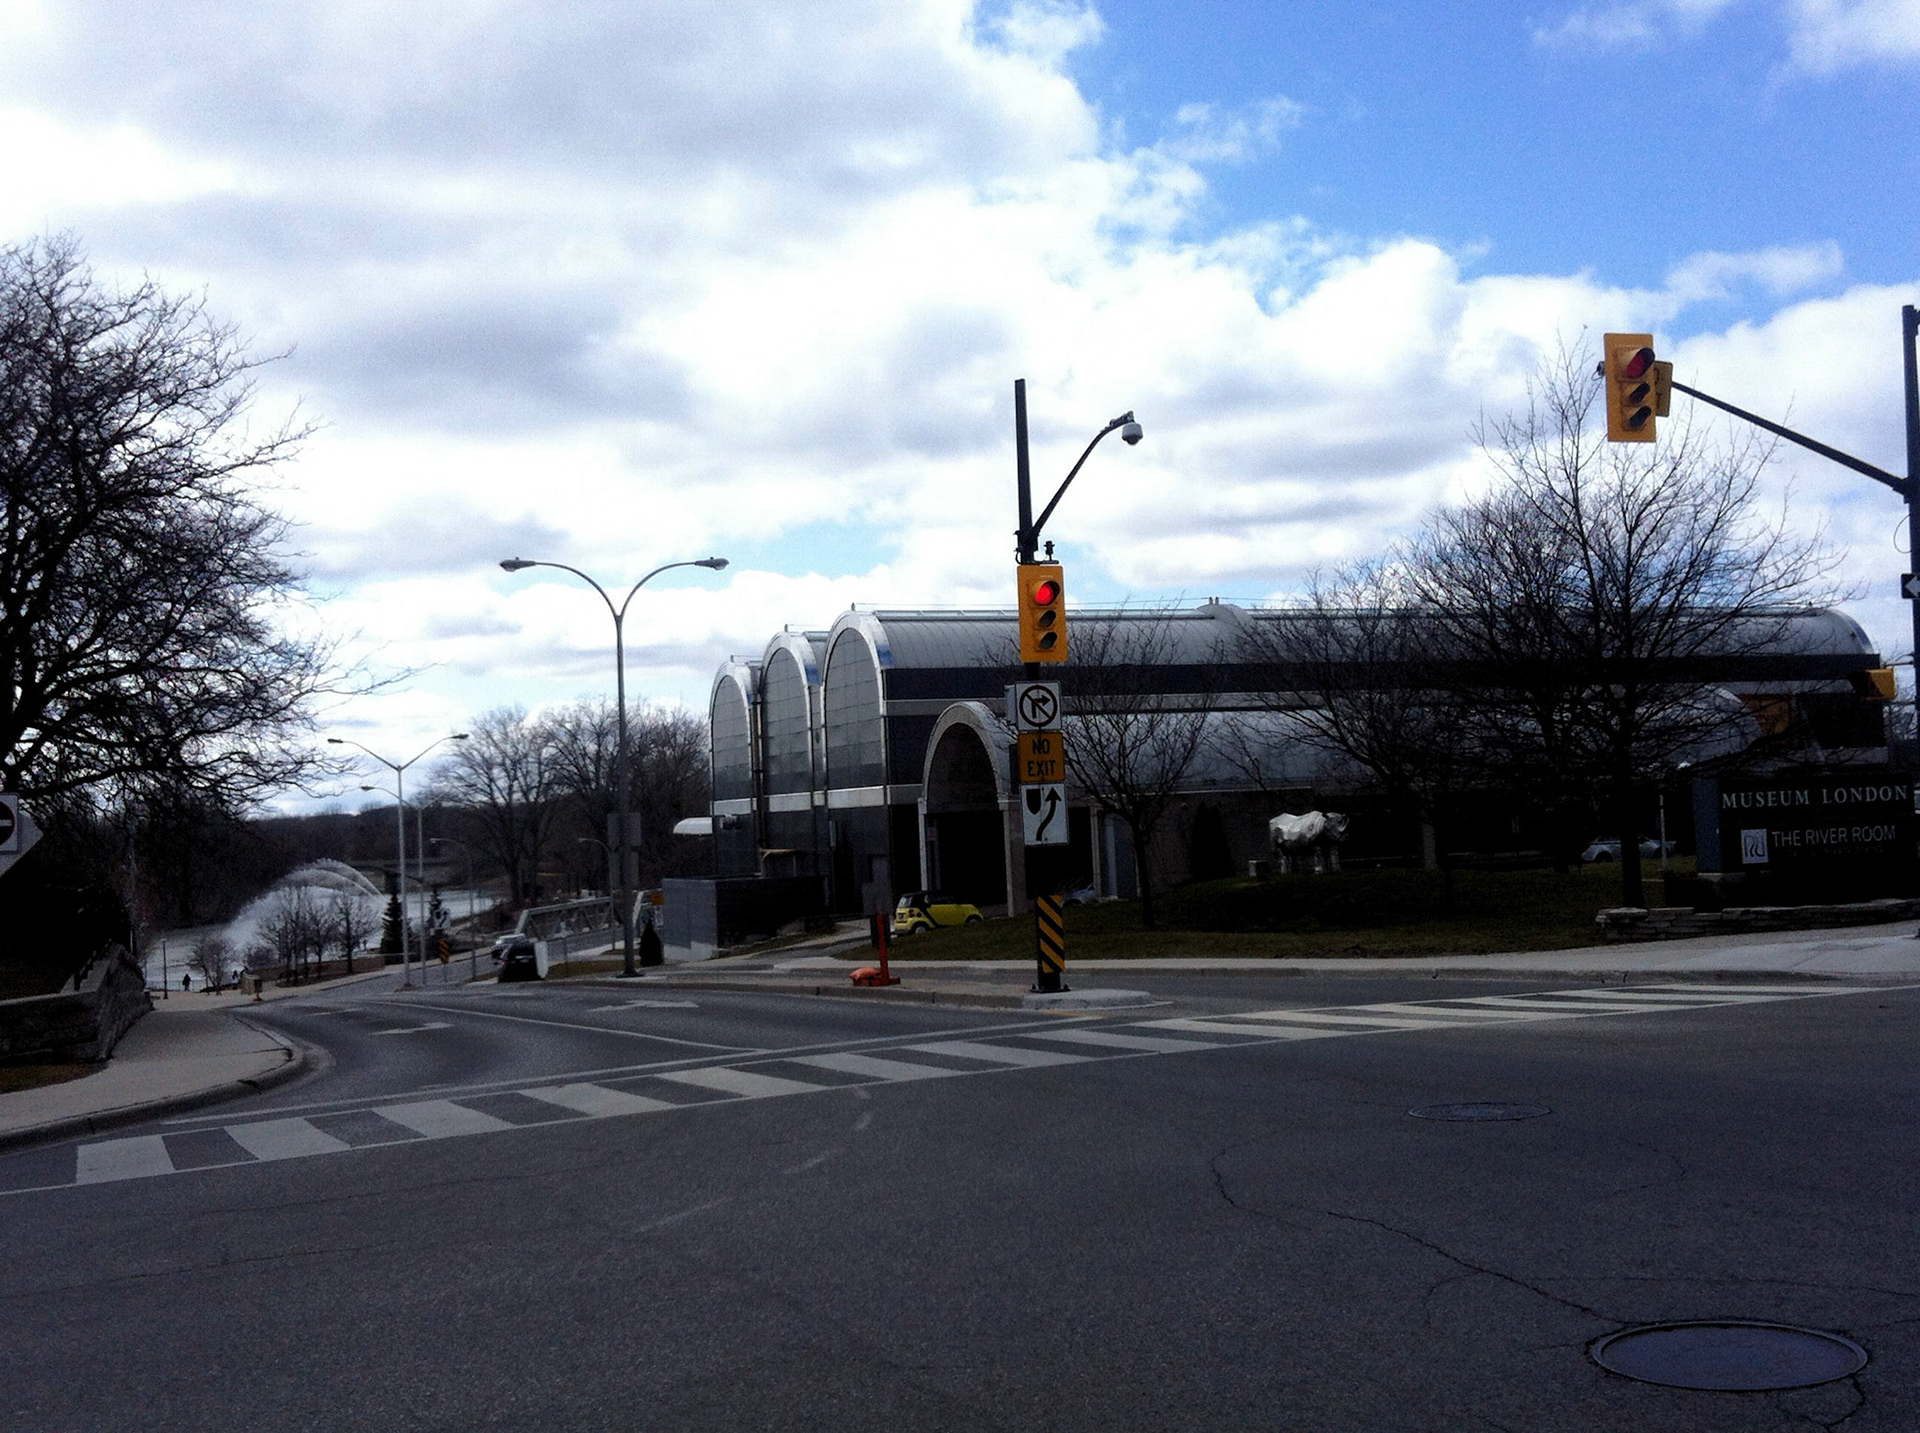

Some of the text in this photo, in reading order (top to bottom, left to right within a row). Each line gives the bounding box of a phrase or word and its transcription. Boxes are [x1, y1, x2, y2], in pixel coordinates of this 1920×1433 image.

[1032, 739, 1050, 755] NO
[1027, 760, 1056, 777] EXIT
[1721, 785, 1908, 809] MUSEUM LONDON
[1771, 830, 1801, 847] THE
[1805, 827, 1848, 846] RIVER
[1852, 825, 1896, 843] ROOM
